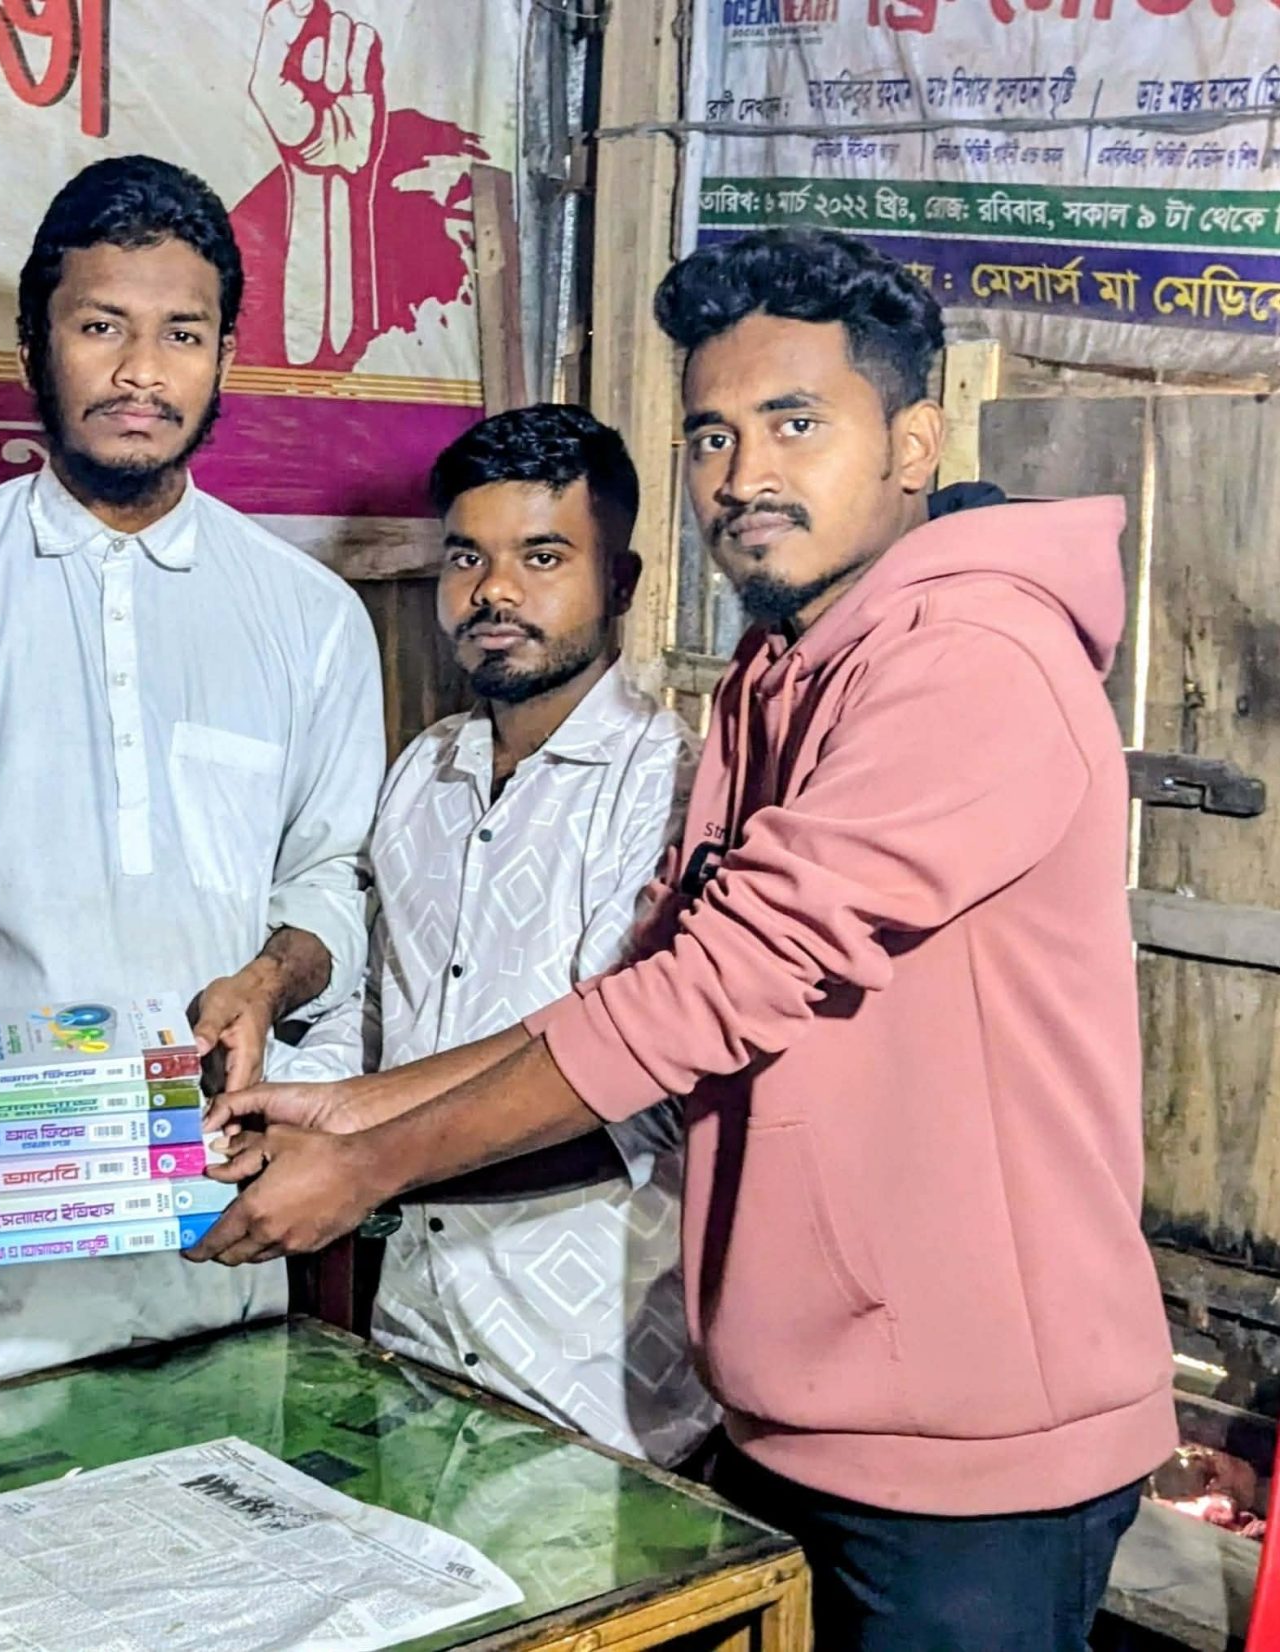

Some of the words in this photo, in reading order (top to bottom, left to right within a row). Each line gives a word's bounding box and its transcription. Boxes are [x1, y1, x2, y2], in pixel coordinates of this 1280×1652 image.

[814, 191, 868, 218] ২০২২
[977, 190, 1055, 231] রবিবার,
[1063, 201, 1131, 230] সকাল
[1137, 204, 1156, 228] ৯
[1165, 199, 1194, 231] টা
[1199, 206, 1268, 234] থেকে
[972, 255, 1084, 305] মেসার্স
[1091, 267, 1141, 312] মা
[1154, 263, 1280, 322] মেডিে
[60, 1201, 116, 1222] ইতিহাস
